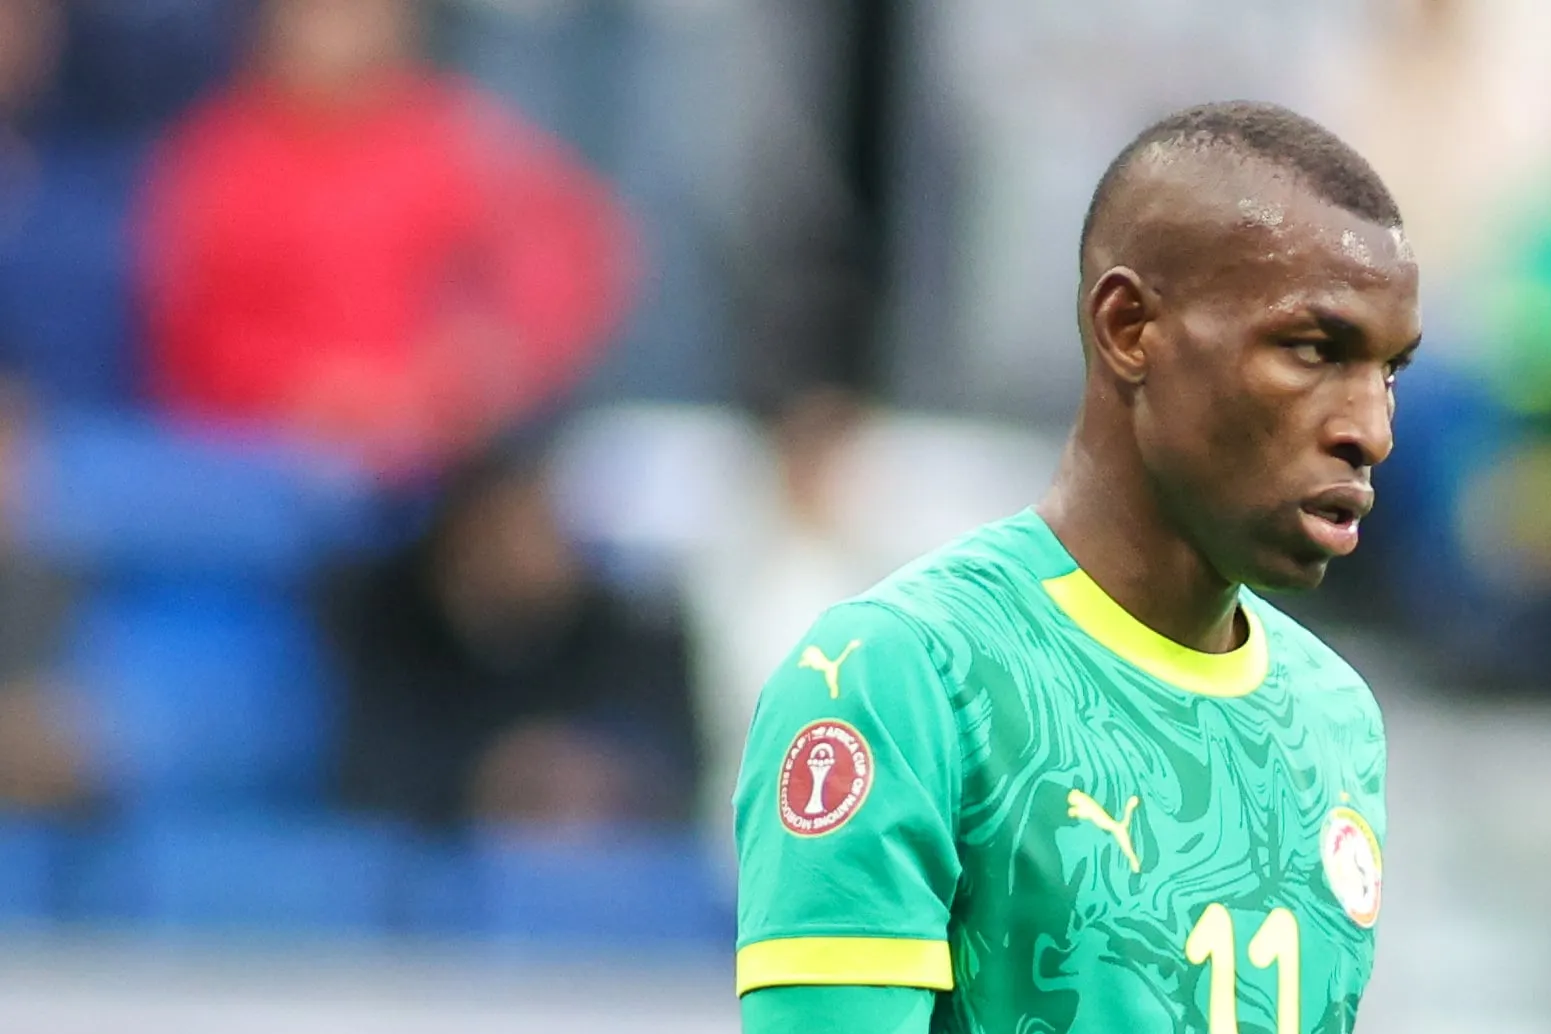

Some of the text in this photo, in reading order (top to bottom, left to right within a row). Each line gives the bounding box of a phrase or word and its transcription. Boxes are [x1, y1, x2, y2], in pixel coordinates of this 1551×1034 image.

[825, 726, 859, 755] AFRICA
[852, 751, 867, 777] CUP
[851, 777, 864, 796] OF
[780, 786, 812, 830] MOROCCO
[813, 793, 857, 829] NATIONS
